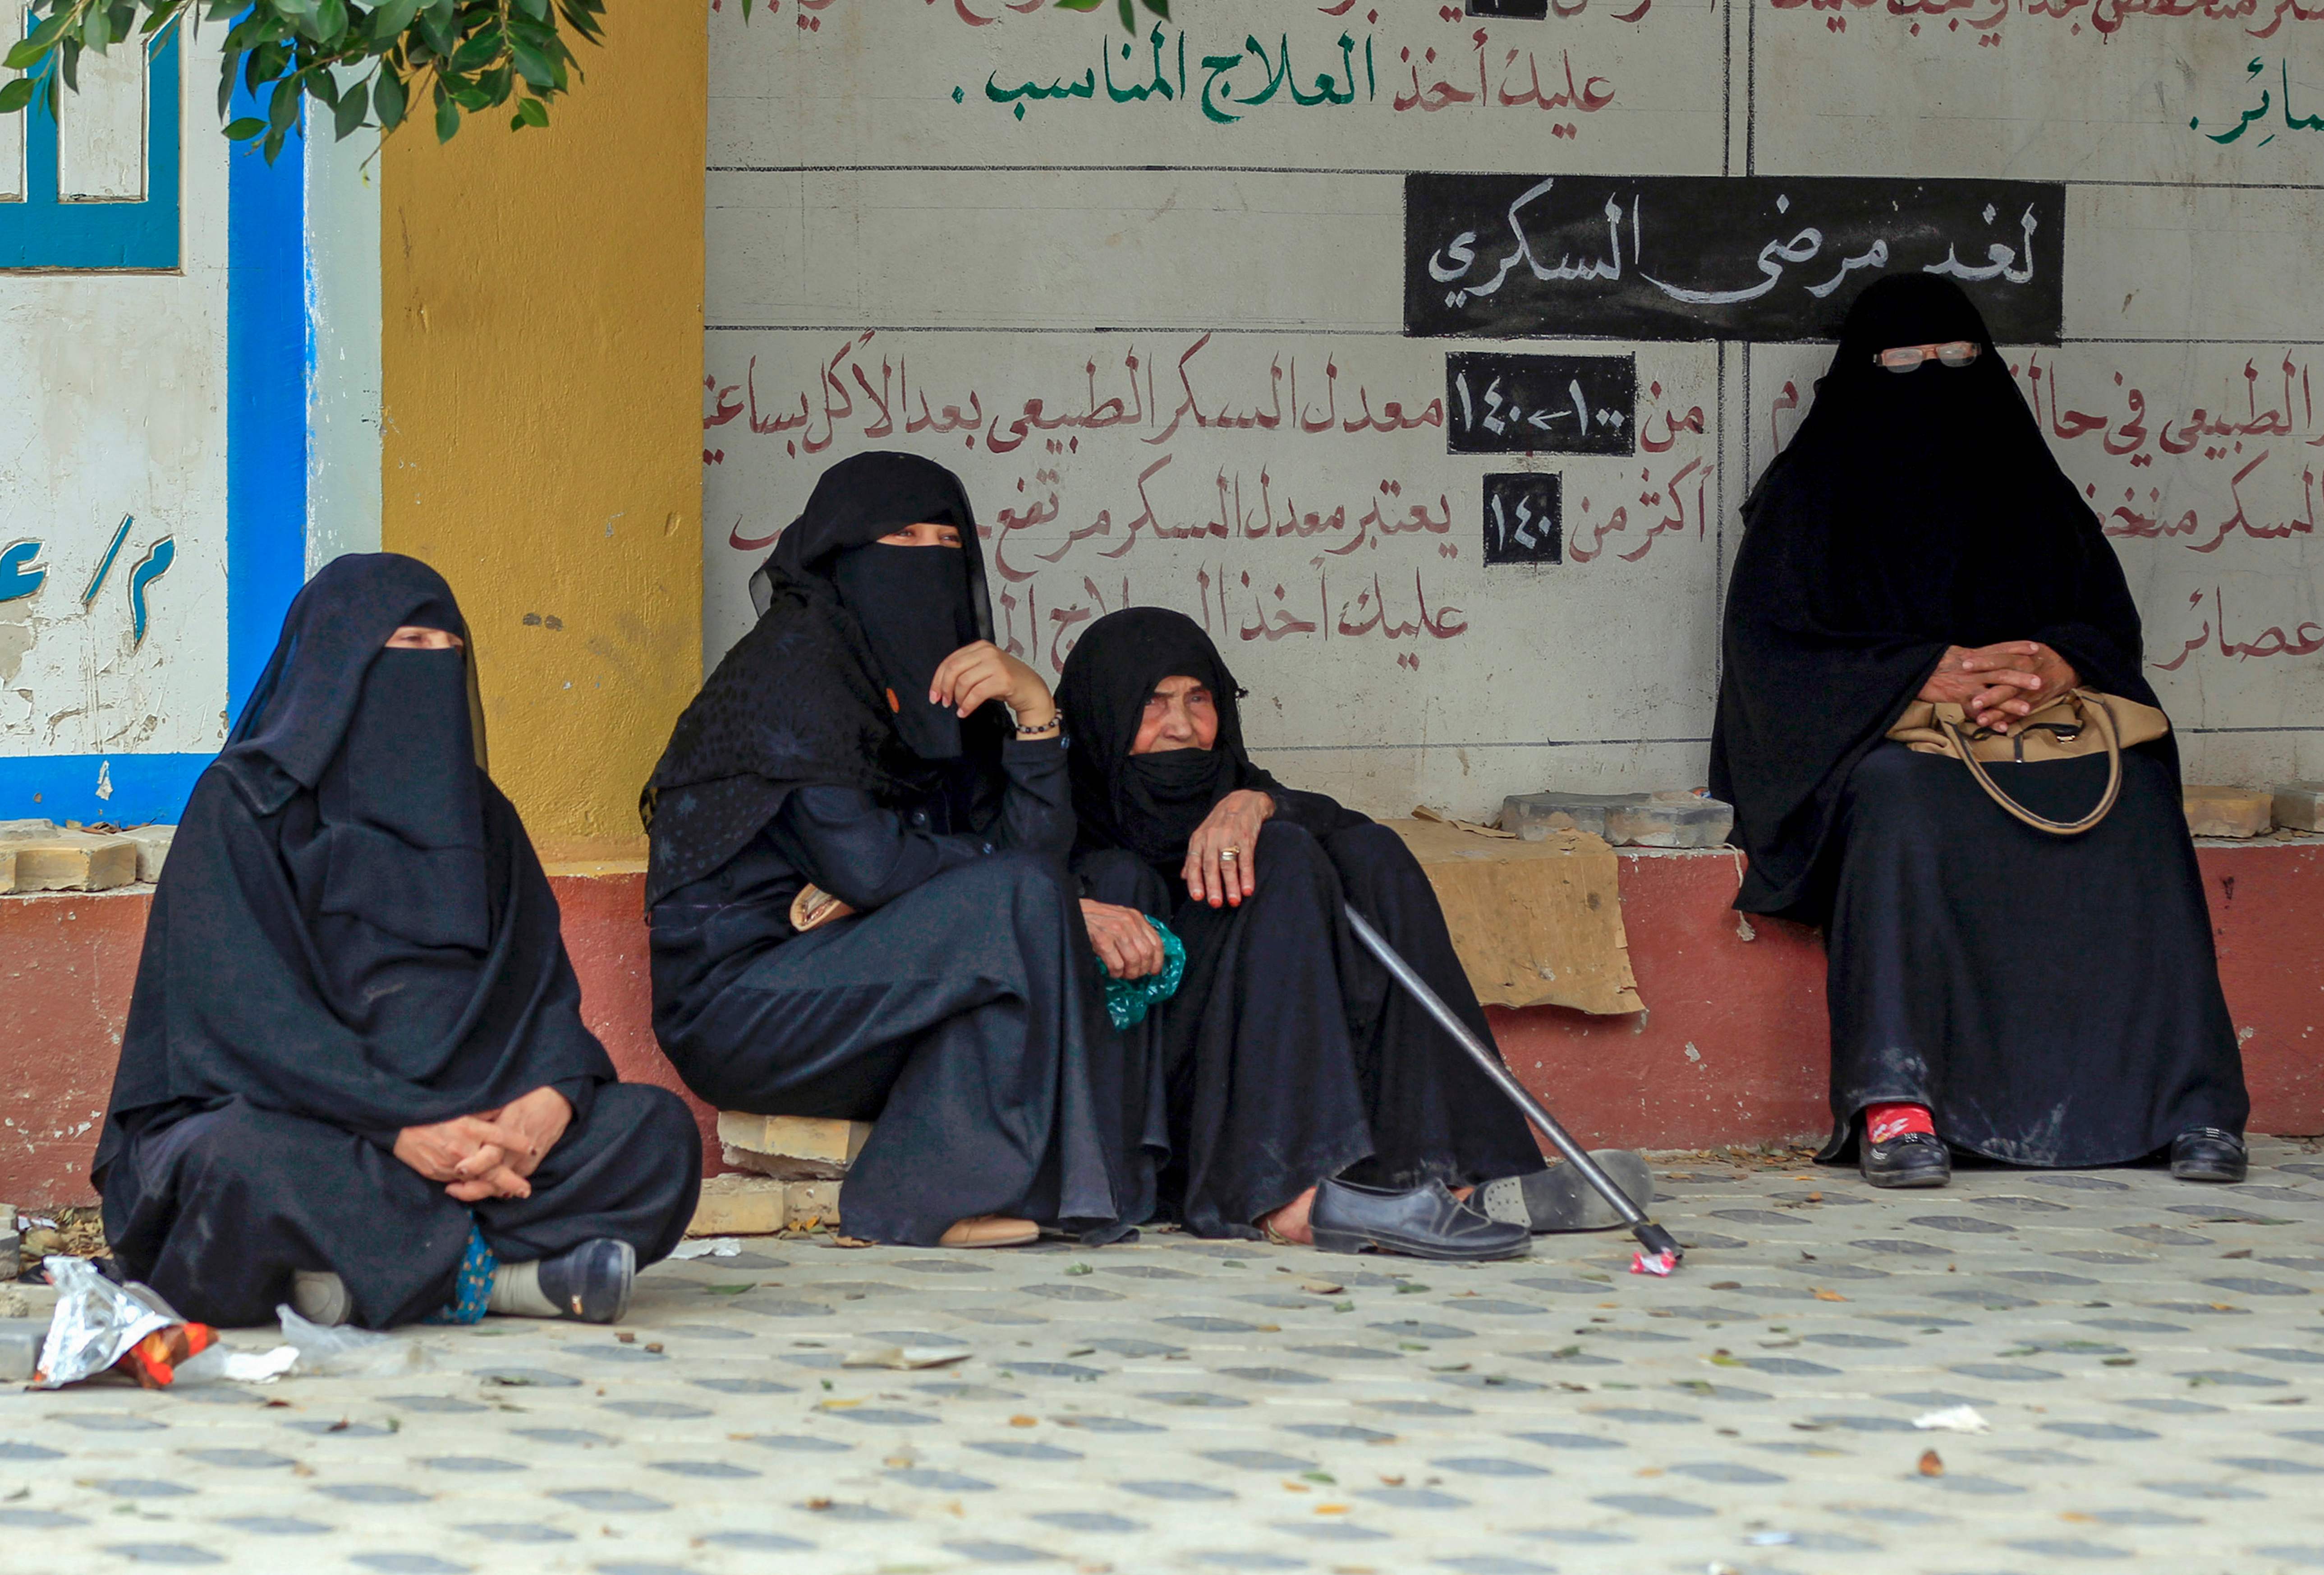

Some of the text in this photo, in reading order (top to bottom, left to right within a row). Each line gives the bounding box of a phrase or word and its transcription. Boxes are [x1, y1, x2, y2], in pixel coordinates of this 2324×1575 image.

[1200, 29, 1375, 124] العلاج
[1428, 177, 1640, 309] السكري
[905, 386, 982, 450] بعد
[1142, 332, 1297, 445] السكر
[1299, 351, 1444, 433] معدل
[1640, 381, 1704, 453] من
[1097, 453, 1240, 558] السكر
[1245, 463, 1346, 539] معدل
[1324, 479, 1459, 559] يعتبر
[1491, 494, 1551, 551] ١٤٠
[1569, 496, 1628, 563] من
